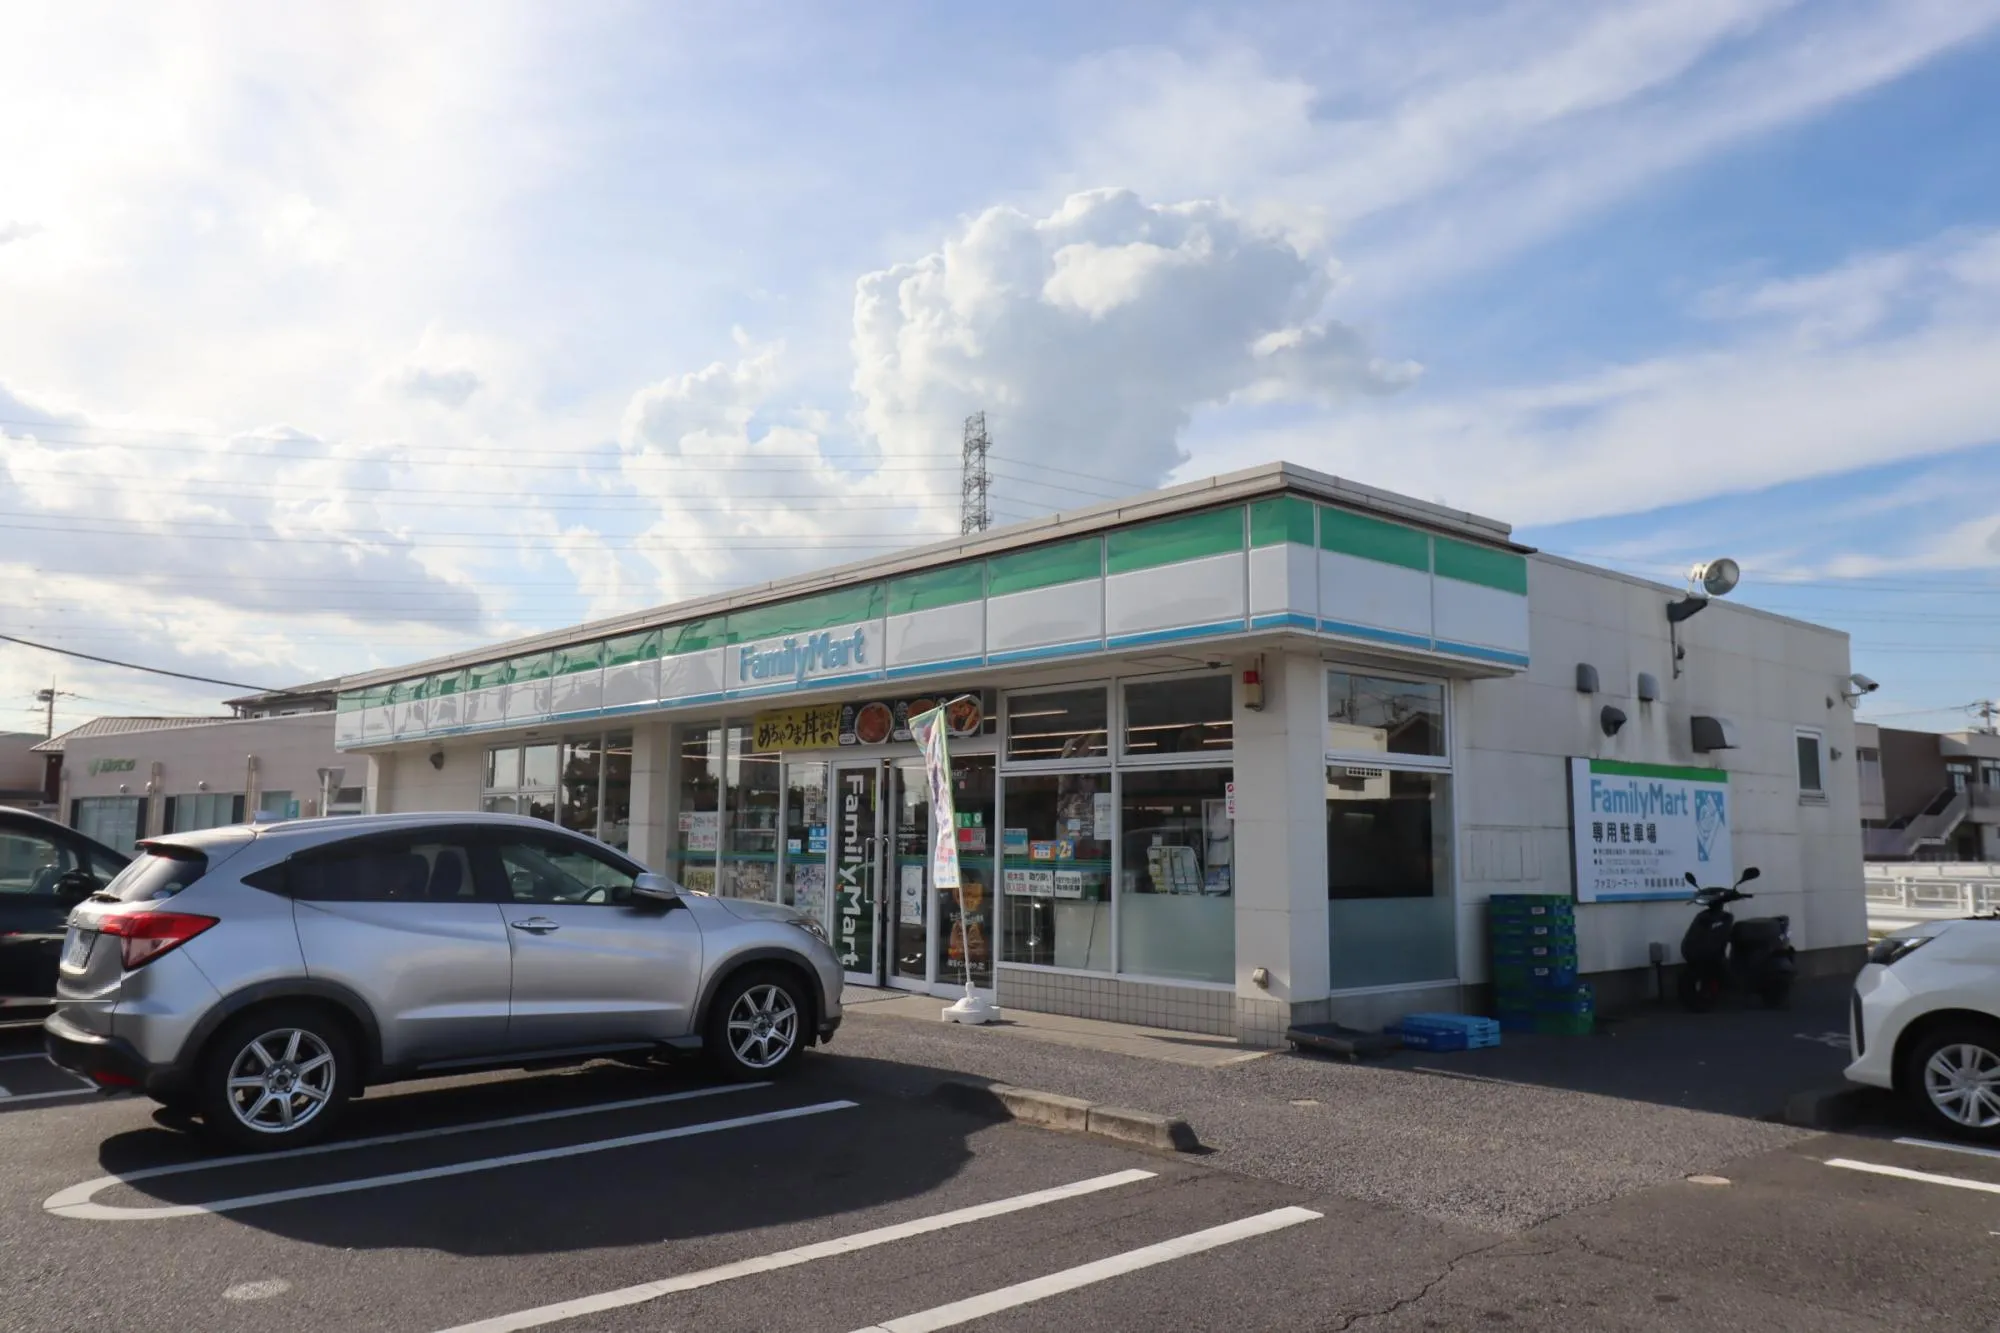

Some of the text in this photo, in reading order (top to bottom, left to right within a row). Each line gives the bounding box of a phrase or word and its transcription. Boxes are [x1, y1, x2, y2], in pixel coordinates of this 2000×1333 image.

[740, 626, 865, 689] FamilyMart
[1590, 779, 1689, 820] FamilyMart
[1592, 822, 1657, 844] 専用駐車場
[839, 774, 864, 966] FamilyMart
